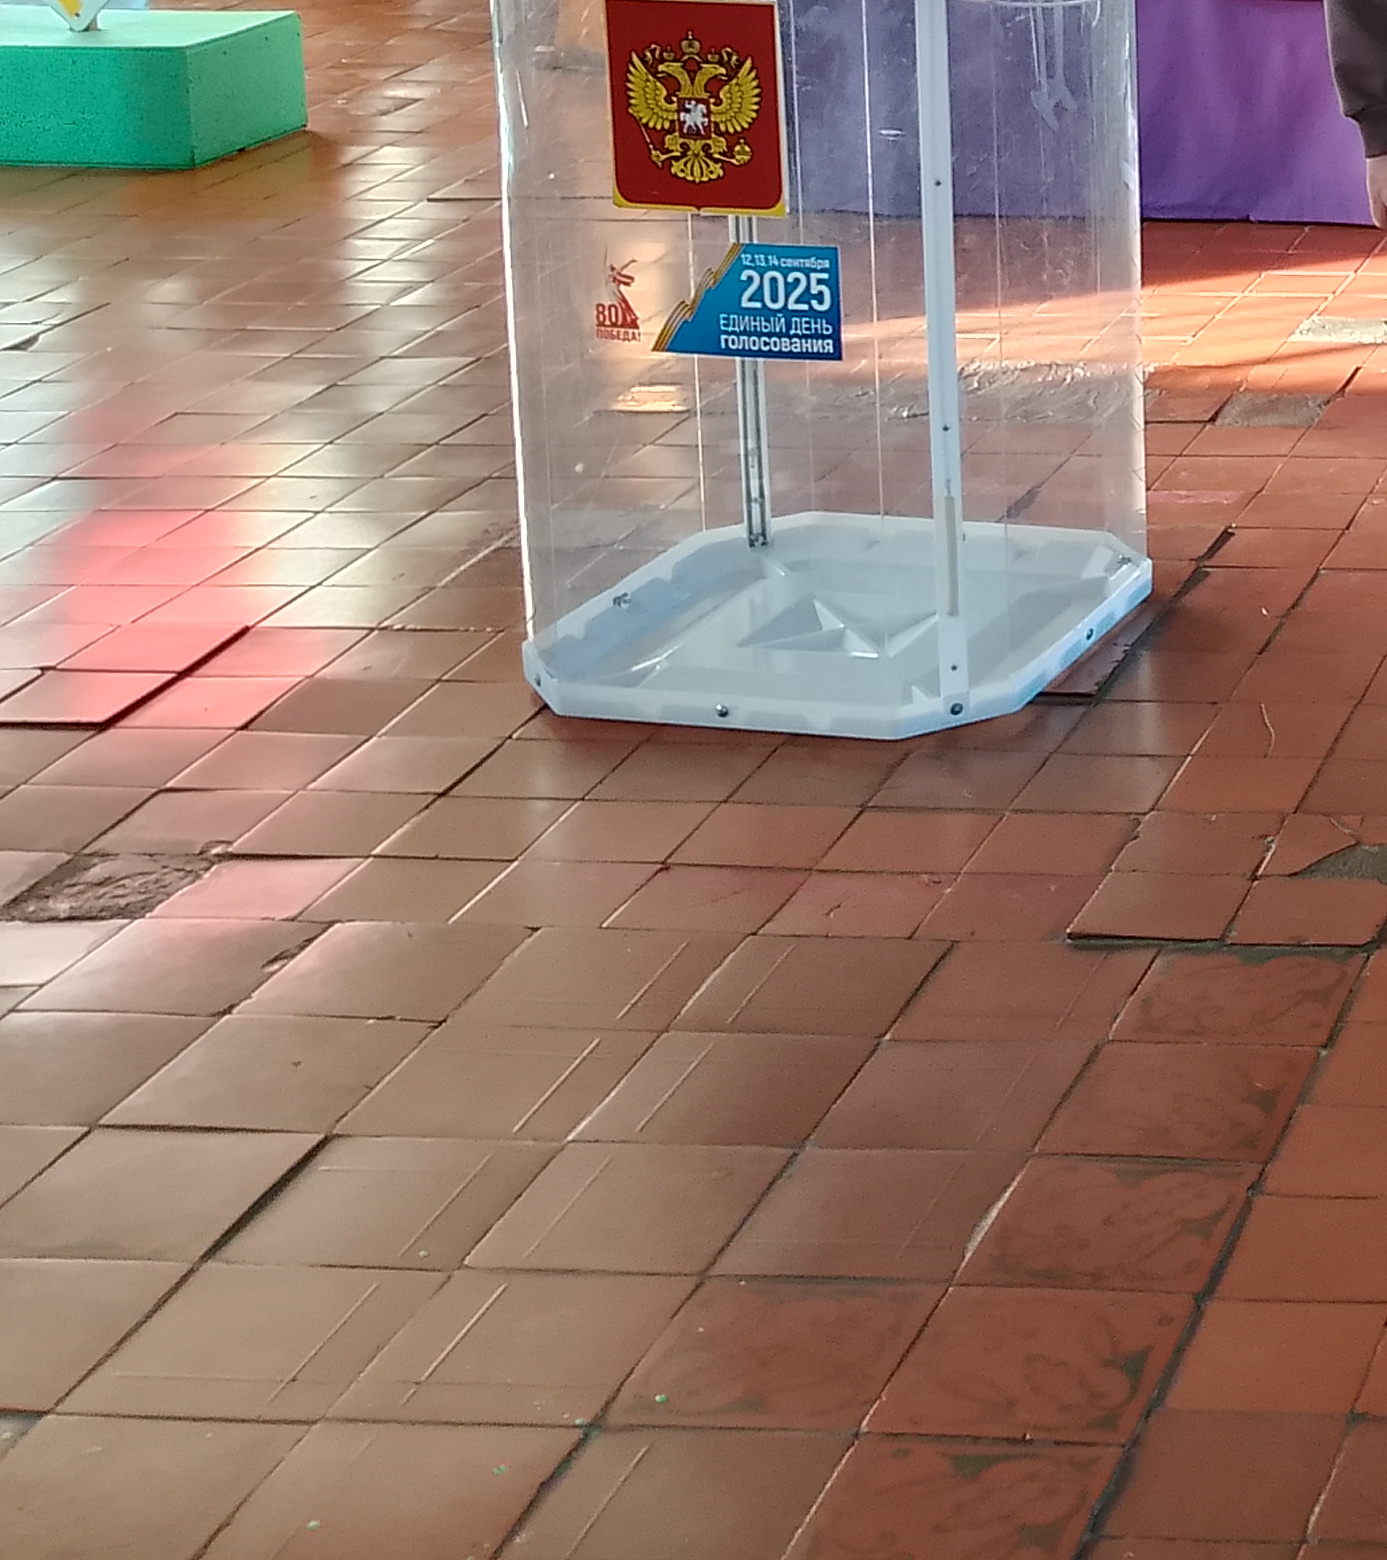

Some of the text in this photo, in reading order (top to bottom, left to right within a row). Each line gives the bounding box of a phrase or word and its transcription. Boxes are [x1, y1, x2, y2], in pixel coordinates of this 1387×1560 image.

[741, 269, 831, 311] 2025
[595, 303, 619, 325] 80
[719, 313, 833, 336] ЕДИНЫЙ ДЕНЬ
